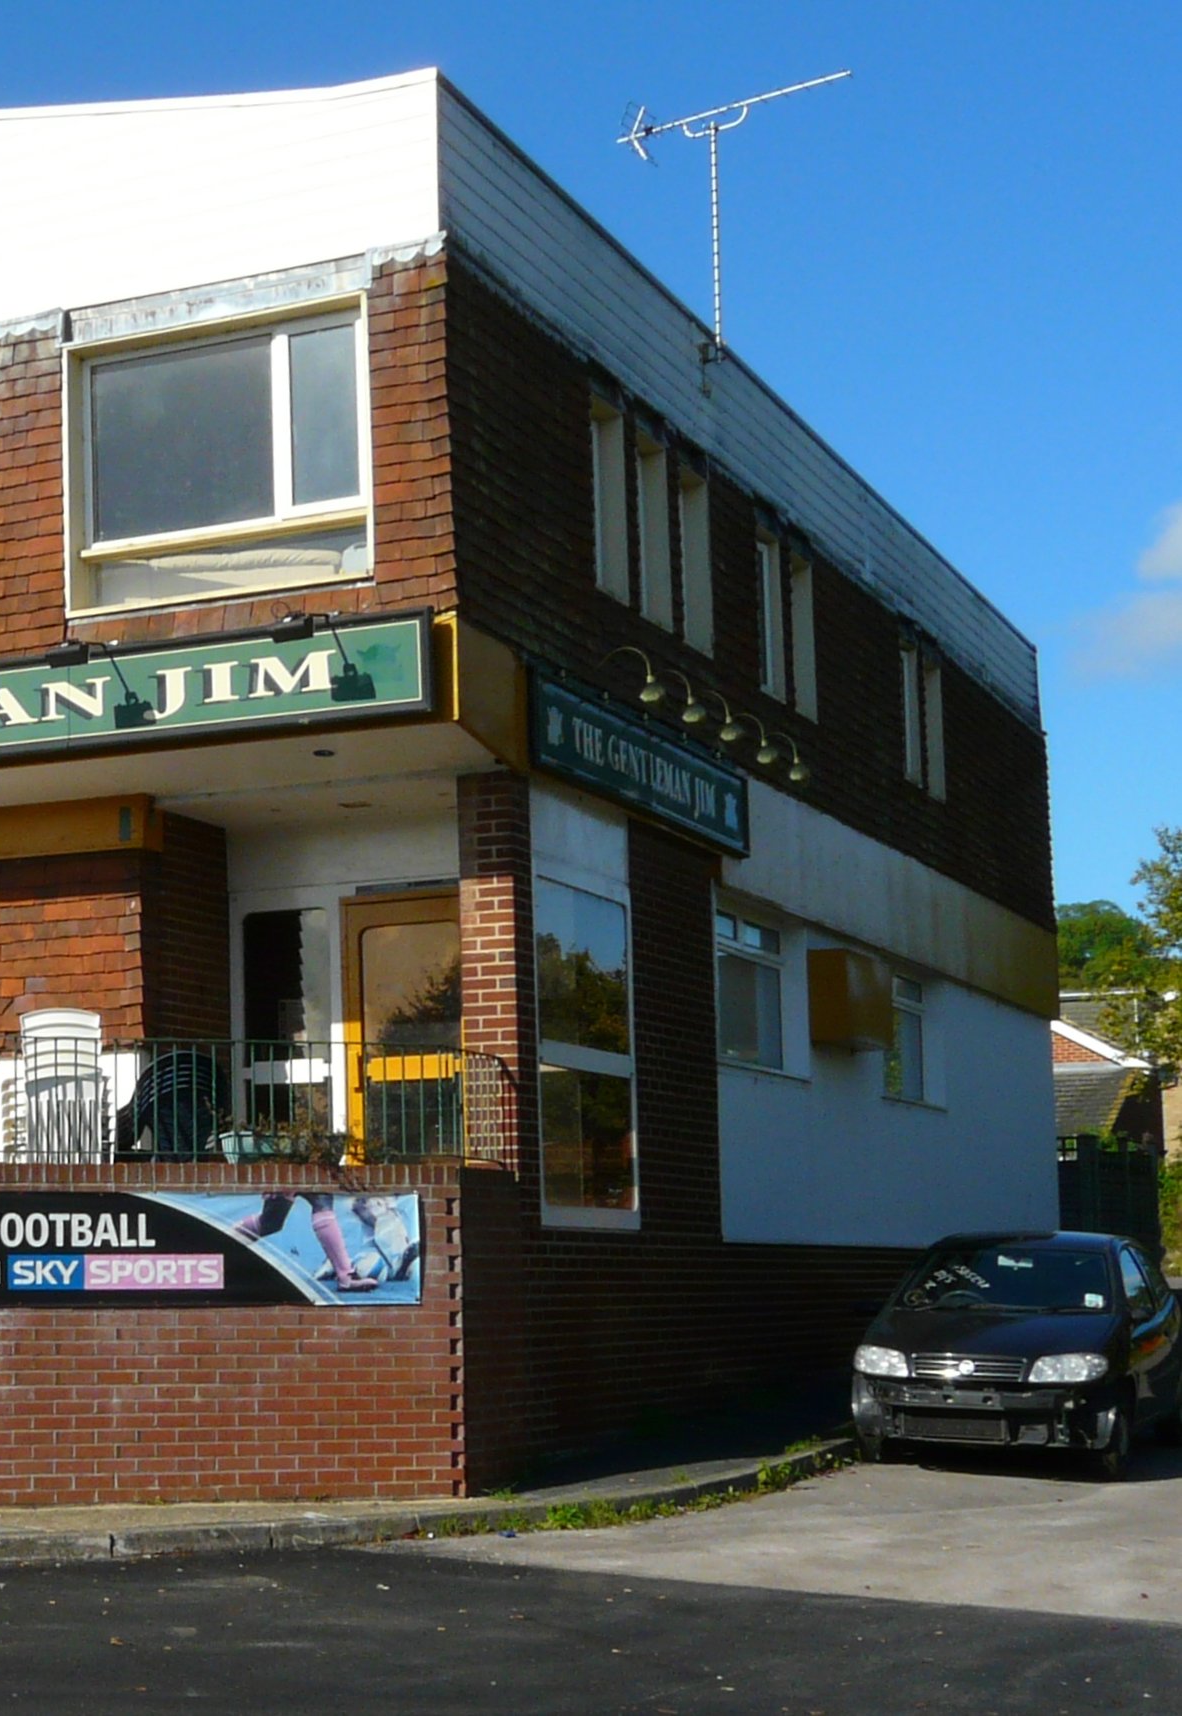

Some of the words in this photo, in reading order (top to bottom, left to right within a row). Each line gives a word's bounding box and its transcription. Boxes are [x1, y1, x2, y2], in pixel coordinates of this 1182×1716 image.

[144, 649, 338, 720] JIM
[572, 716, 604, 767] THE
[607, 734, 692, 808] GENTLEMAN
[694, 777, 717, 820] JIM
[11, 1259, 80, 1286] SKY
[88, 1257, 222, 1286] SPORTS
